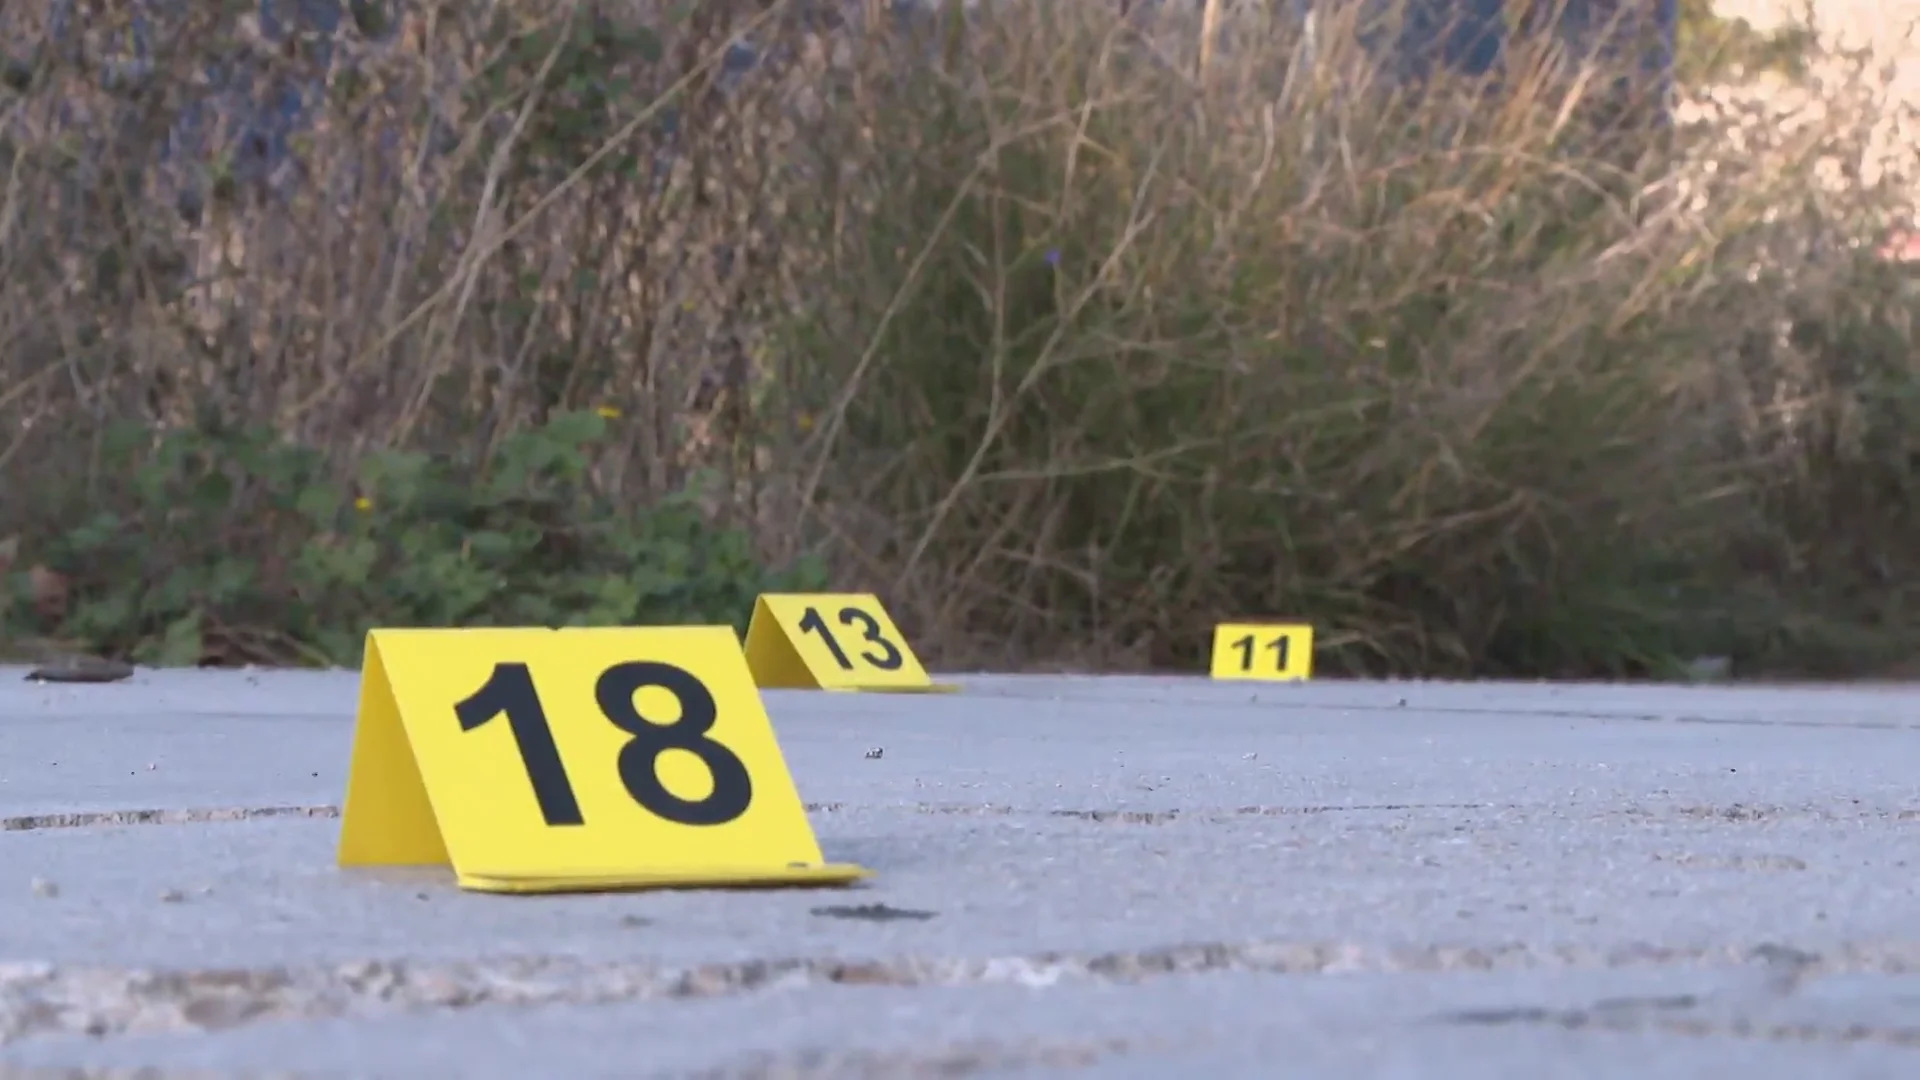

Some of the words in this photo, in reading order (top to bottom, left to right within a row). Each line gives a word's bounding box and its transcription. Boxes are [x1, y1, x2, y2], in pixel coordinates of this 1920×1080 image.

[798, 607, 903, 670] 13
[1231, 635, 1289, 671] 11
[454, 661, 752, 826] 18
